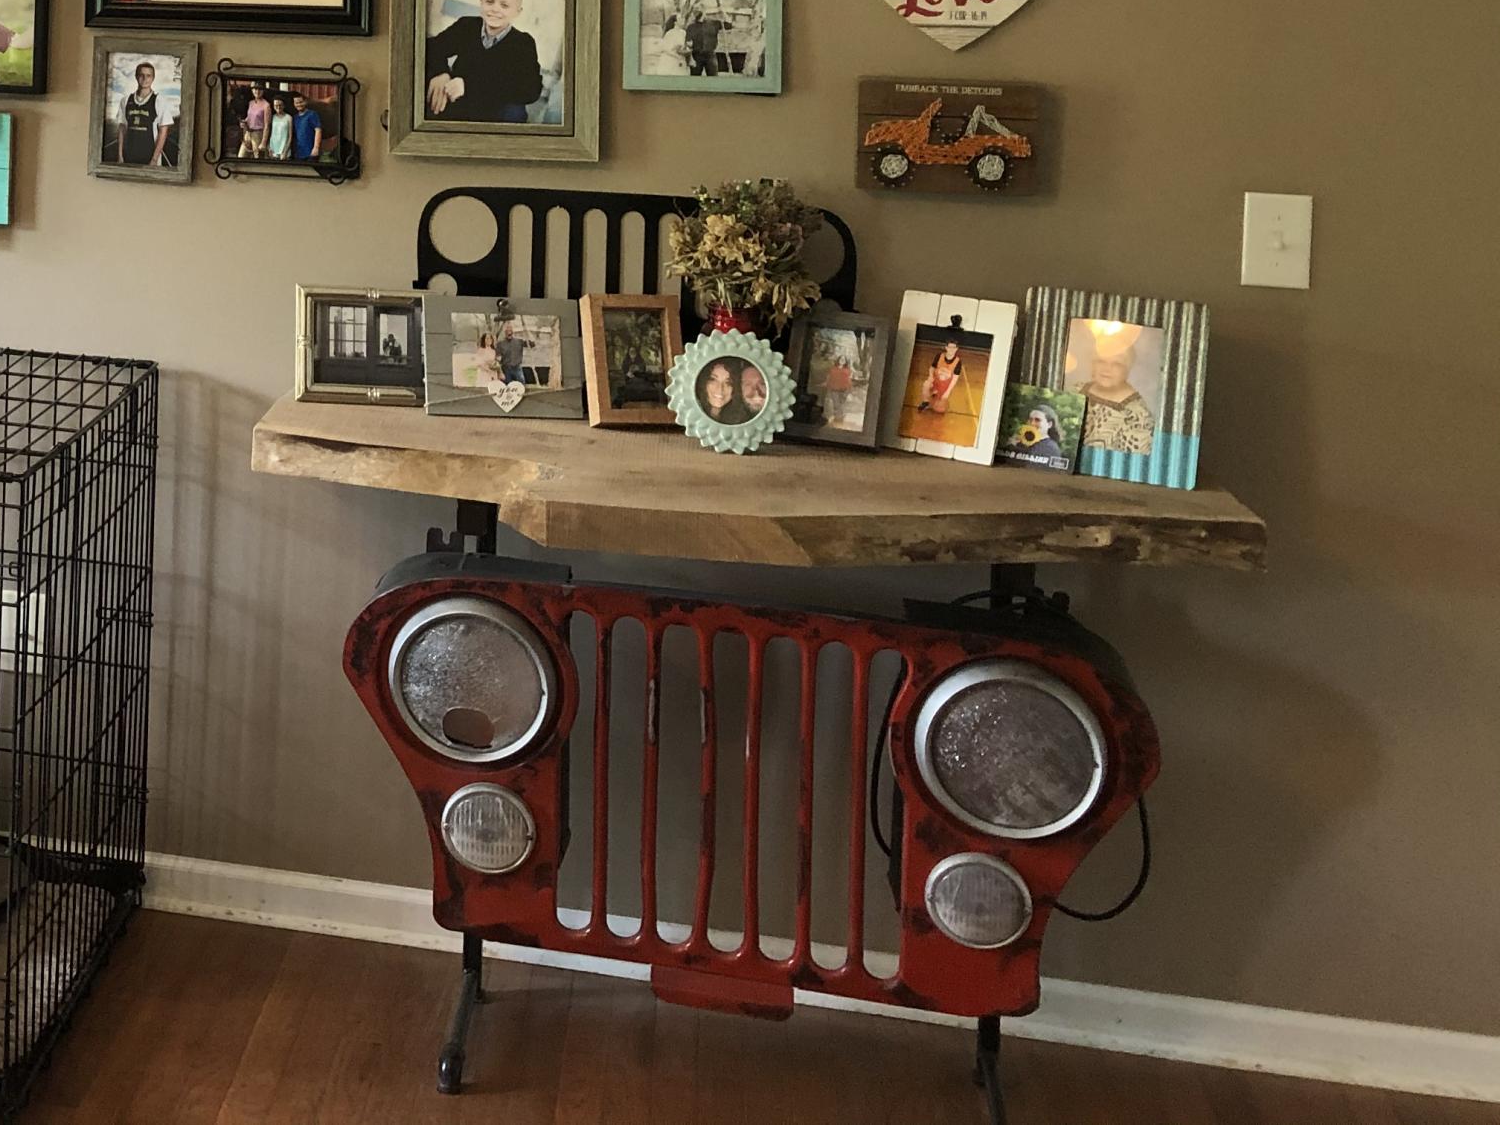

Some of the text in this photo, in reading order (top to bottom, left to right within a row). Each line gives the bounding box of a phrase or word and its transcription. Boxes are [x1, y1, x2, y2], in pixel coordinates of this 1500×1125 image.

[895, 83, 1003, 96] EMBRACE THE DETOURS
